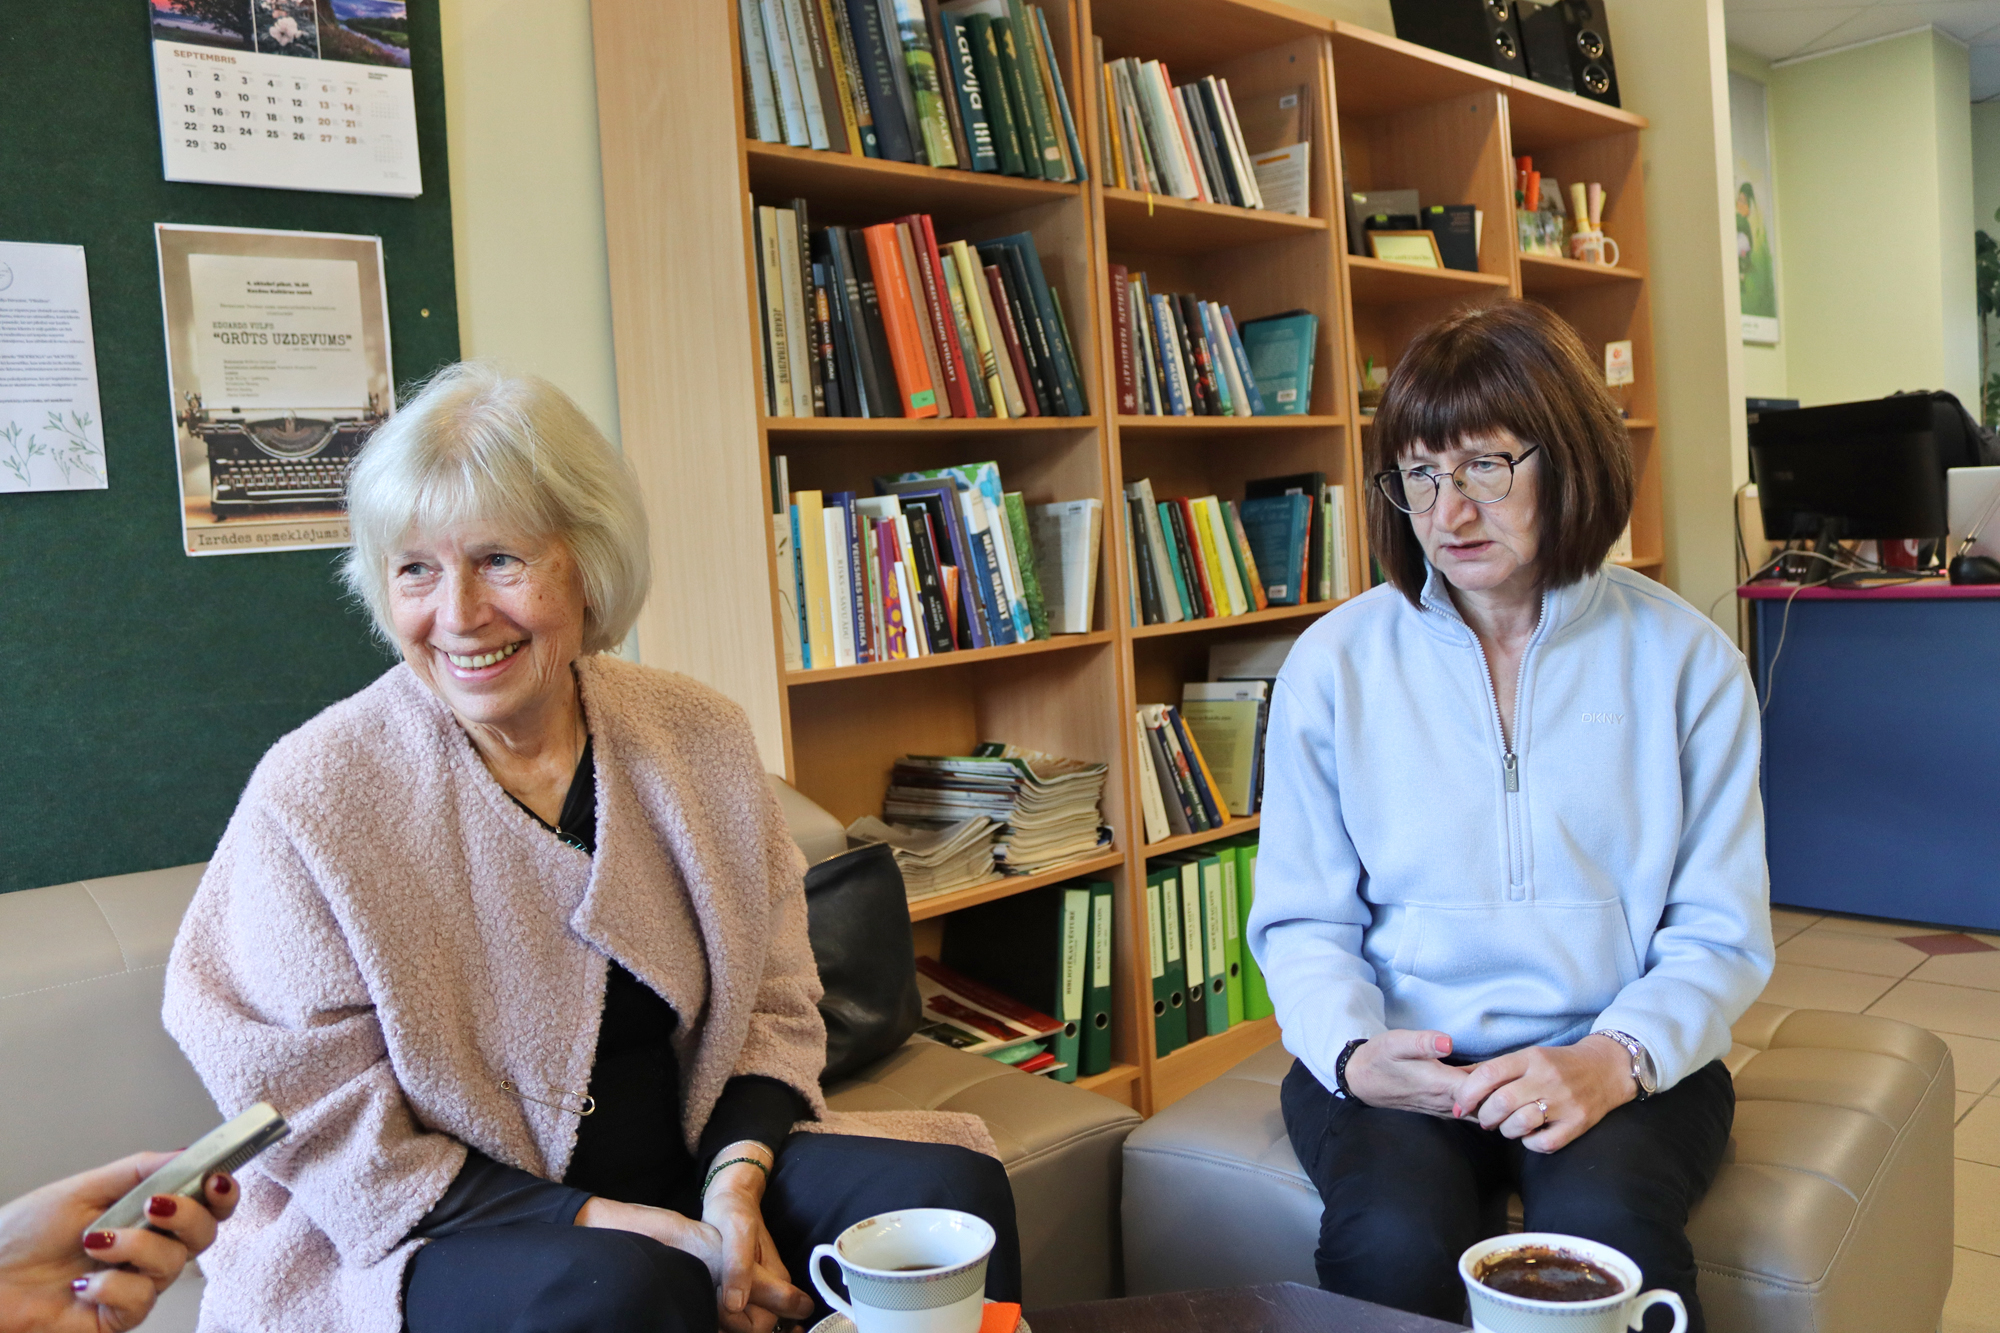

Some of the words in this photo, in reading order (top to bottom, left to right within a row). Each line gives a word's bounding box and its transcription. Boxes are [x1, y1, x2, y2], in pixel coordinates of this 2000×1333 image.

[174, 49, 237, 64] SEPTEMBRIS
[954, 24, 983, 111] Latvija
[187, 70, 192, 78] 1
[242, 77, 247, 85] 3
[267, 80, 273, 88] 4
[295, 82, 300, 90] 5
[322, 85, 328, 93] 6
[347, 87, 353, 95] 7
[184, 105, 195, 113] 15
[212, 108, 223, 116] 16
[240, 111, 250, 119] 17
[267, 113, 277, 121] 18
[294, 116, 303, 124] 19
[318, 118, 330, 126] 20
[346, 120, 355, 128] 21
[292, 99, 302, 107] 12
[344, 103, 354, 111] 14
[212, 125, 224, 133] 23
[240, 128, 252, 136] 24
[267, 130, 278, 138] 25
[293, 133, 305, 141] 26
[937, 101, 952, 148] LATVIJA
[186, 140, 198, 148] 29
[214, 142, 226, 151] 30
[941, 341, 956, 381] LATVIJAS
[199, 533, 252, 546] Izrādes
[256, 528, 339, 545] apmeklējums
[851, 542, 862, 594] VEIKSMES
[856, 595, 867, 646] RETORIKA
[1581, 713, 1624, 724] DKNY
[1066, 910, 1075, 943] VĒSTURE
[1064, 944, 1073, 994] BIBLIOTĒKAS
